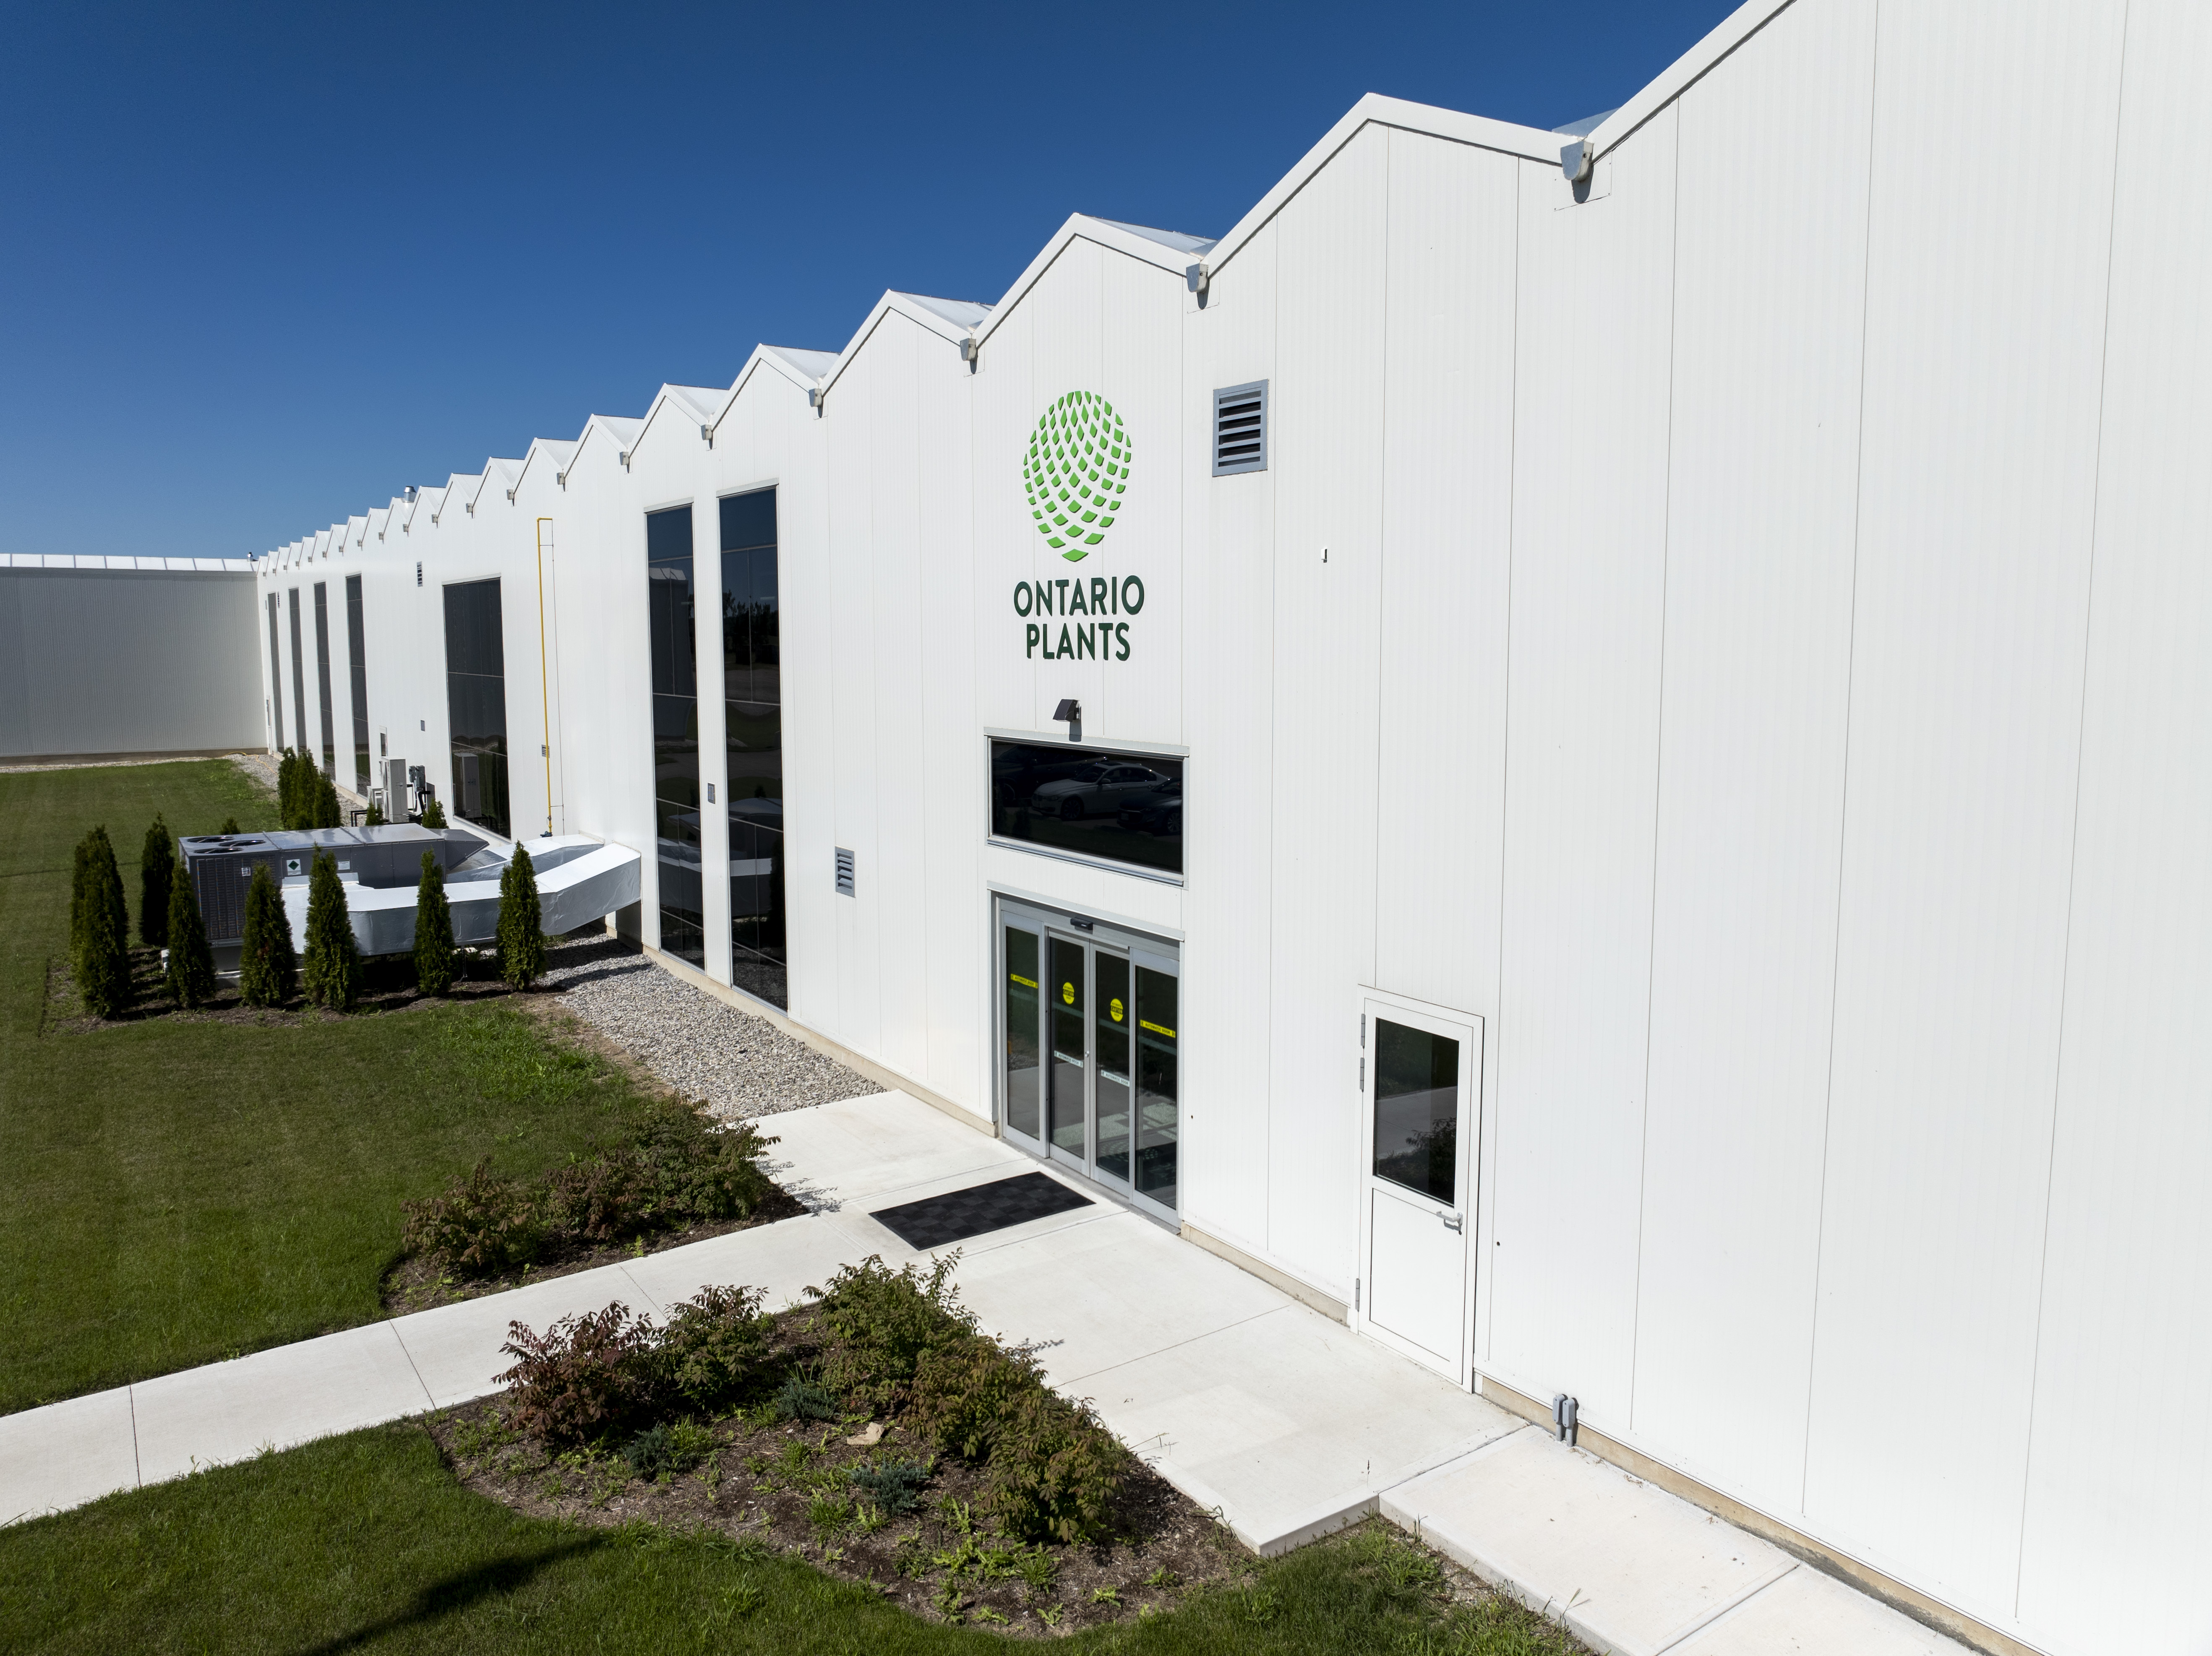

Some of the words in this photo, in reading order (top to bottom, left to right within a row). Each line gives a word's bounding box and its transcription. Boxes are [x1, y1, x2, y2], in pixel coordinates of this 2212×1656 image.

[1014, 575, 1145, 617] ONTARIO
[1026, 622, 1130, 661] PLANTS
[1111, 1006, 1123, 1015] CAUTION
[1145, 1023, 1161, 1031] AUTOMATIC
[1059, 1053, 1072, 1062] AUTOMATIC
[1106, 1073, 1120, 1083] AUTOMATIC
